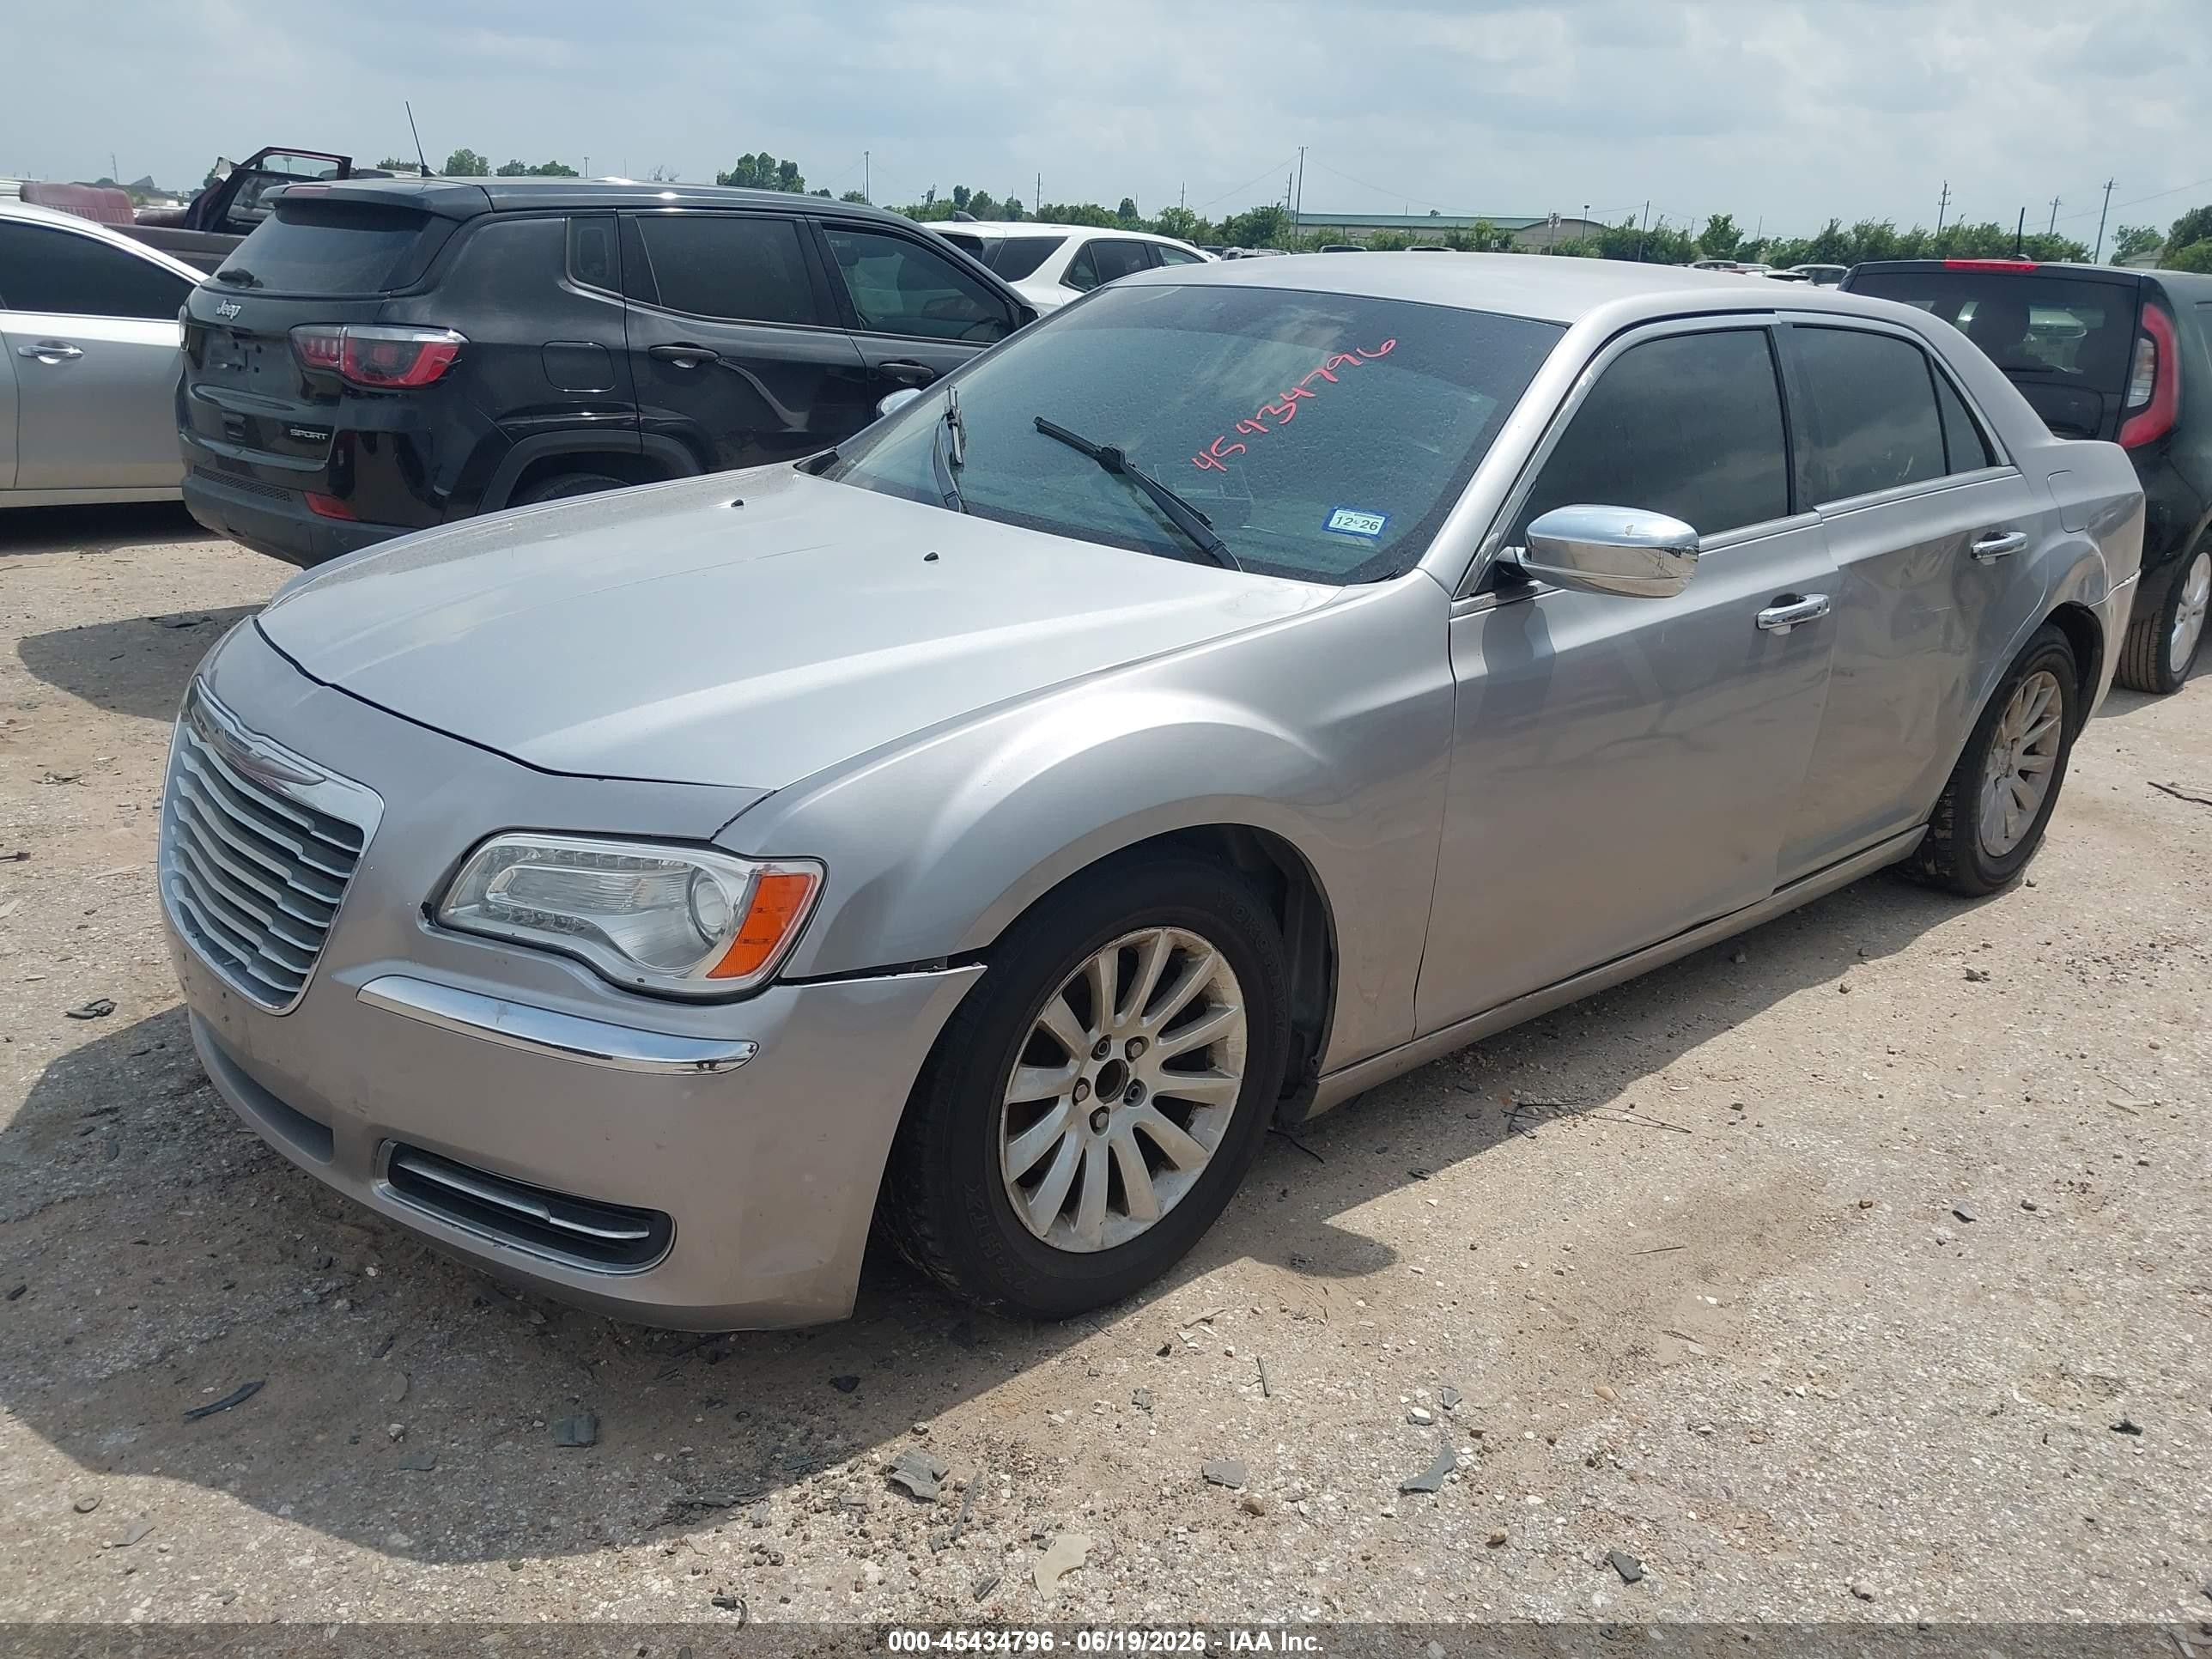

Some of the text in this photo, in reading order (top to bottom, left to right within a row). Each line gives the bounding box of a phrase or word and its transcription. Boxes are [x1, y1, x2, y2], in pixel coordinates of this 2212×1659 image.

[216, 300, 241, 319] Jeep
[1192, 339, 1396, 471] 45434796
[289, 428, 328, 440] SPORT
